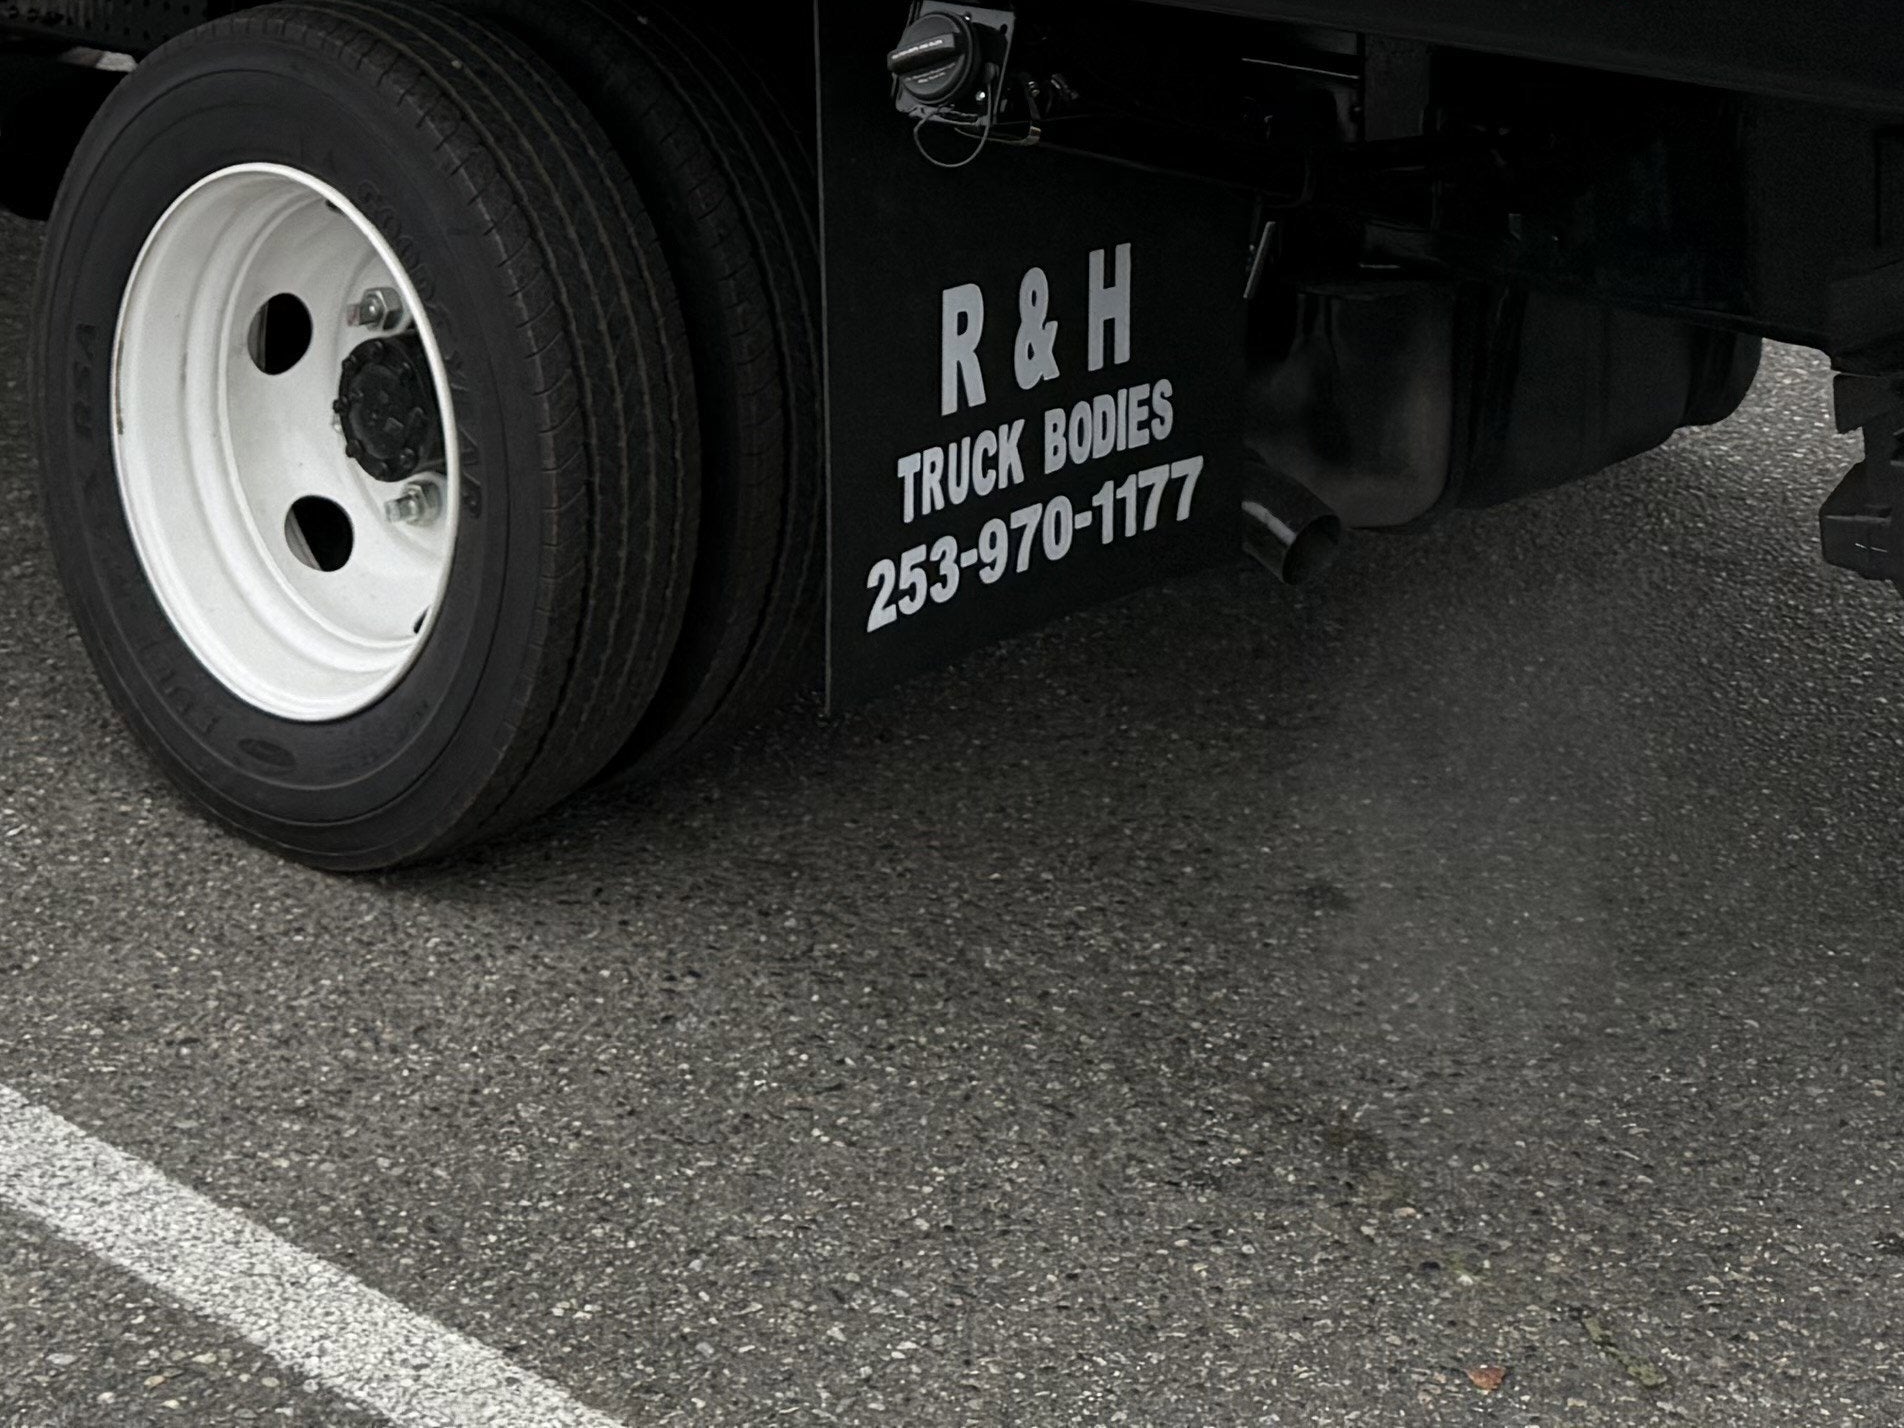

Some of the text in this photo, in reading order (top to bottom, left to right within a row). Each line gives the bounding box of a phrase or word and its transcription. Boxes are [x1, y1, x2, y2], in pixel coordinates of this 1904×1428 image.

[942, 242, 1131, 417] R & H
[897, 379, 1174, 524] TRUCK BODIES
[866, 456, 1204, 633] 253-970-1177
